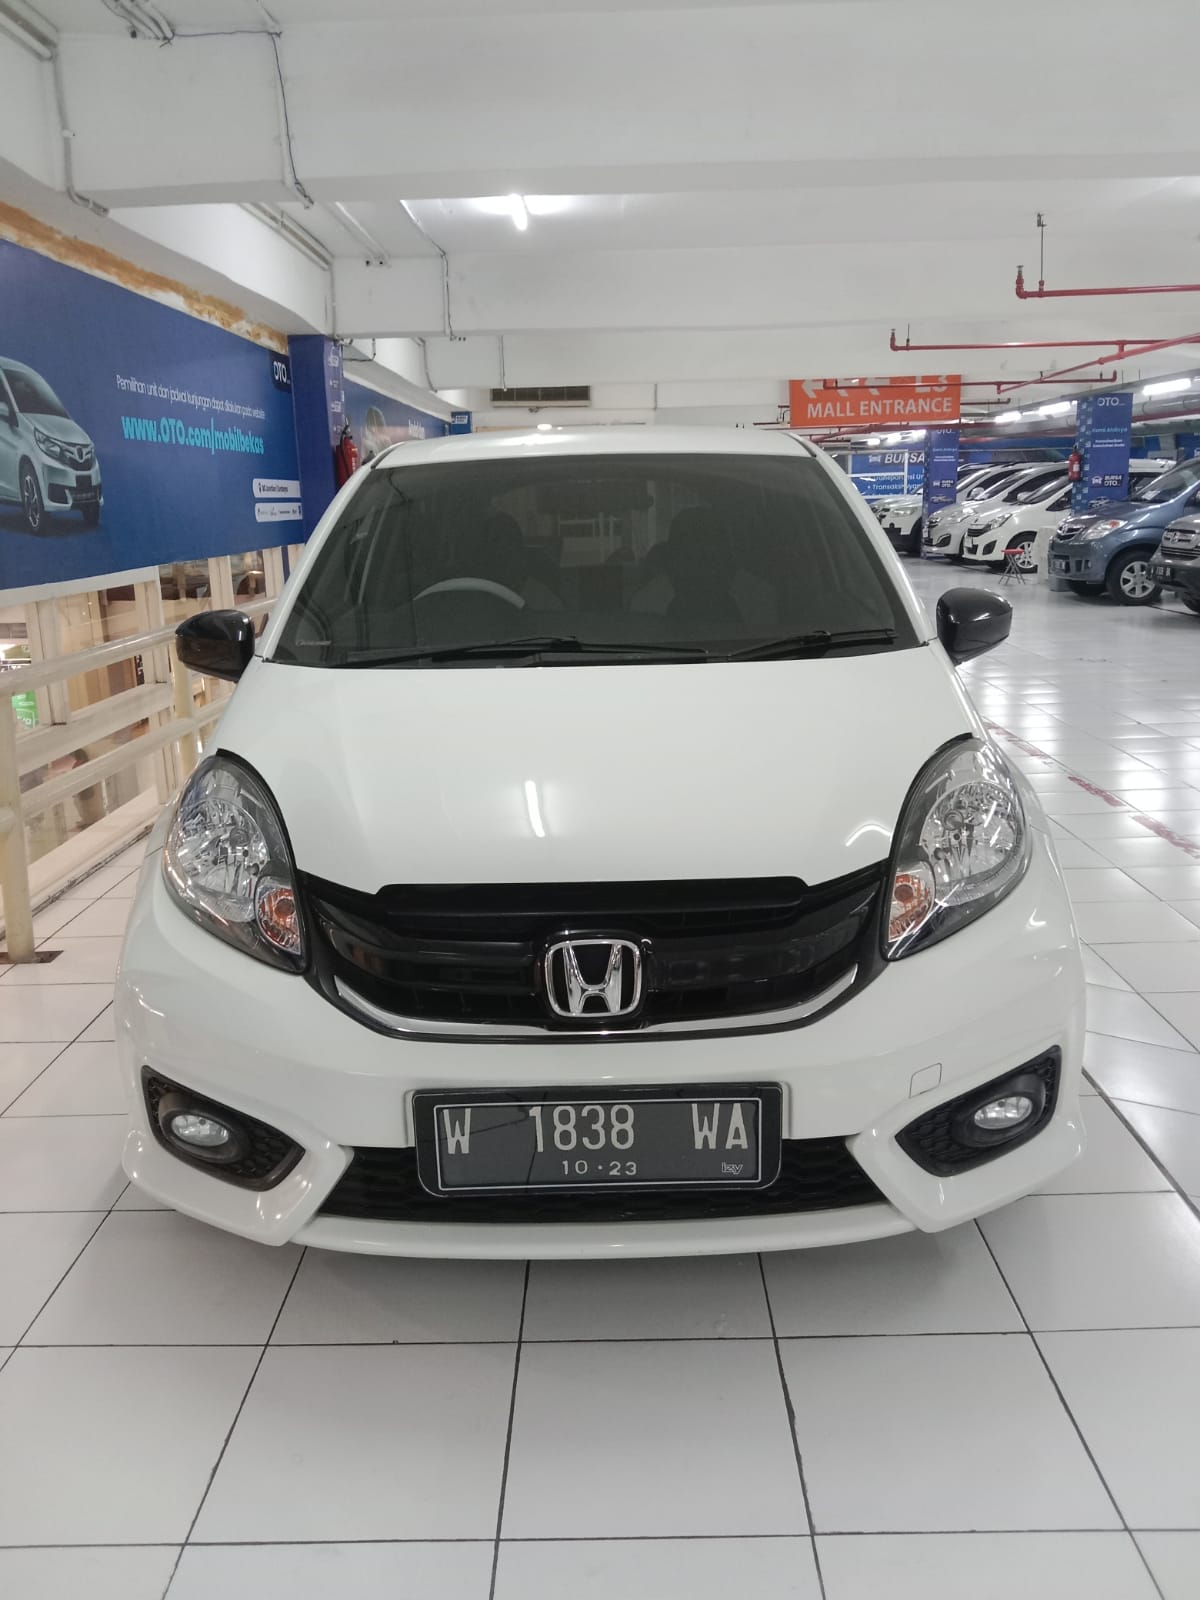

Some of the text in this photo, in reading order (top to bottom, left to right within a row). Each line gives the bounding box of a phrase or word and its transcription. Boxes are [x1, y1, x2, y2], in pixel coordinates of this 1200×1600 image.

[273, 361, 287, 382] OTO
[147, 383, 158, 397] unit
[158, 385, 170, 399] dan
[1097, 396, 1119, 407] OTO
[807, 397, 953, 419] MALL ENTRANCE
[121, 415, 264, 455] www.OTO.com/mobilbekas
[443, 1102, 749, 1155] W 1838 WA
